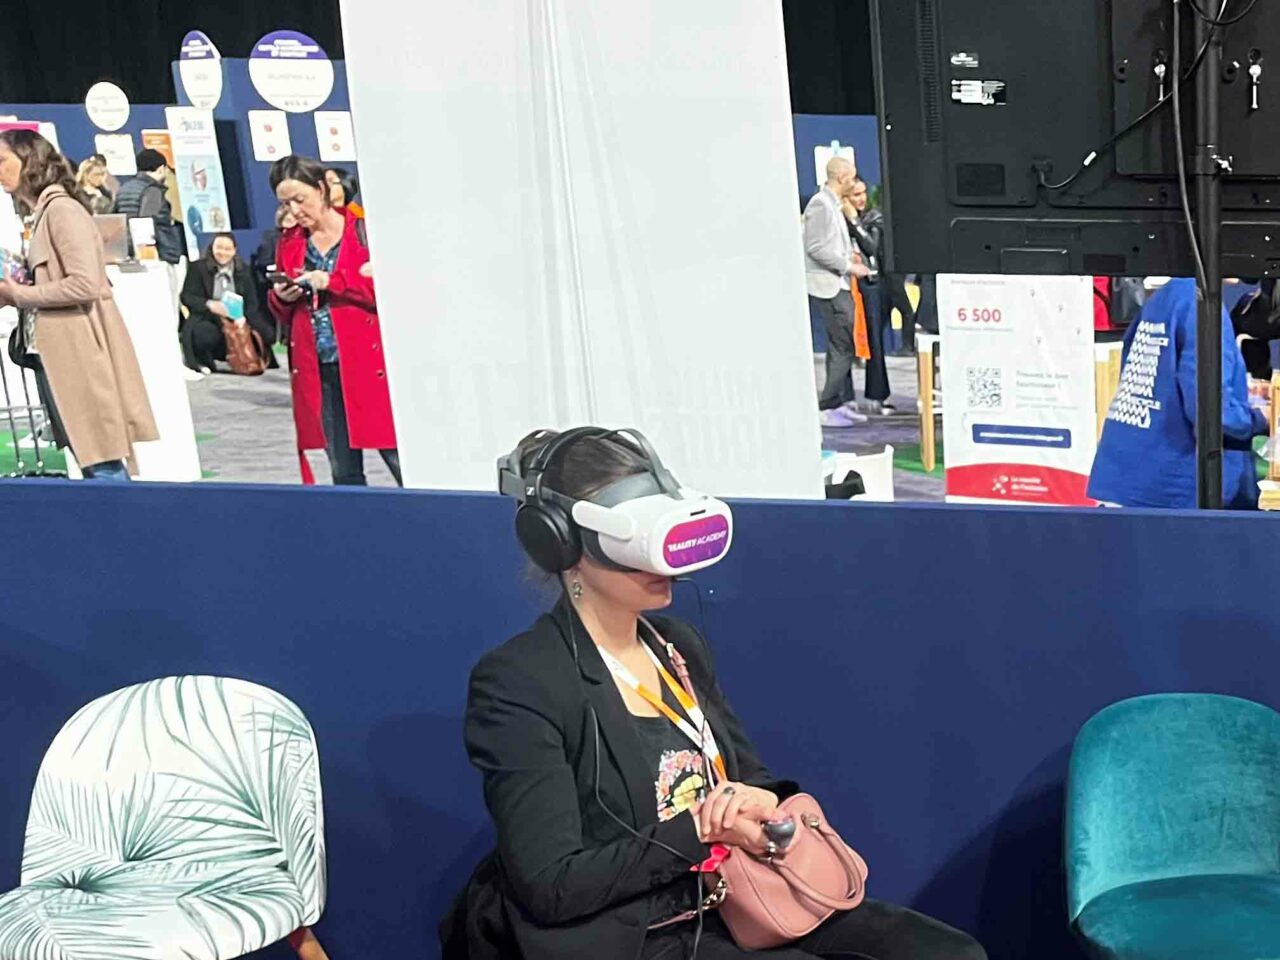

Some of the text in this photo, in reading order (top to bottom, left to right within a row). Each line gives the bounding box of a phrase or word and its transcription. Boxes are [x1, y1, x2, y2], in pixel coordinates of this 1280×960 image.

[958, 308, 1002, 323] 6 500
[667, 530, 727, 553] REALITY ACADEMY
